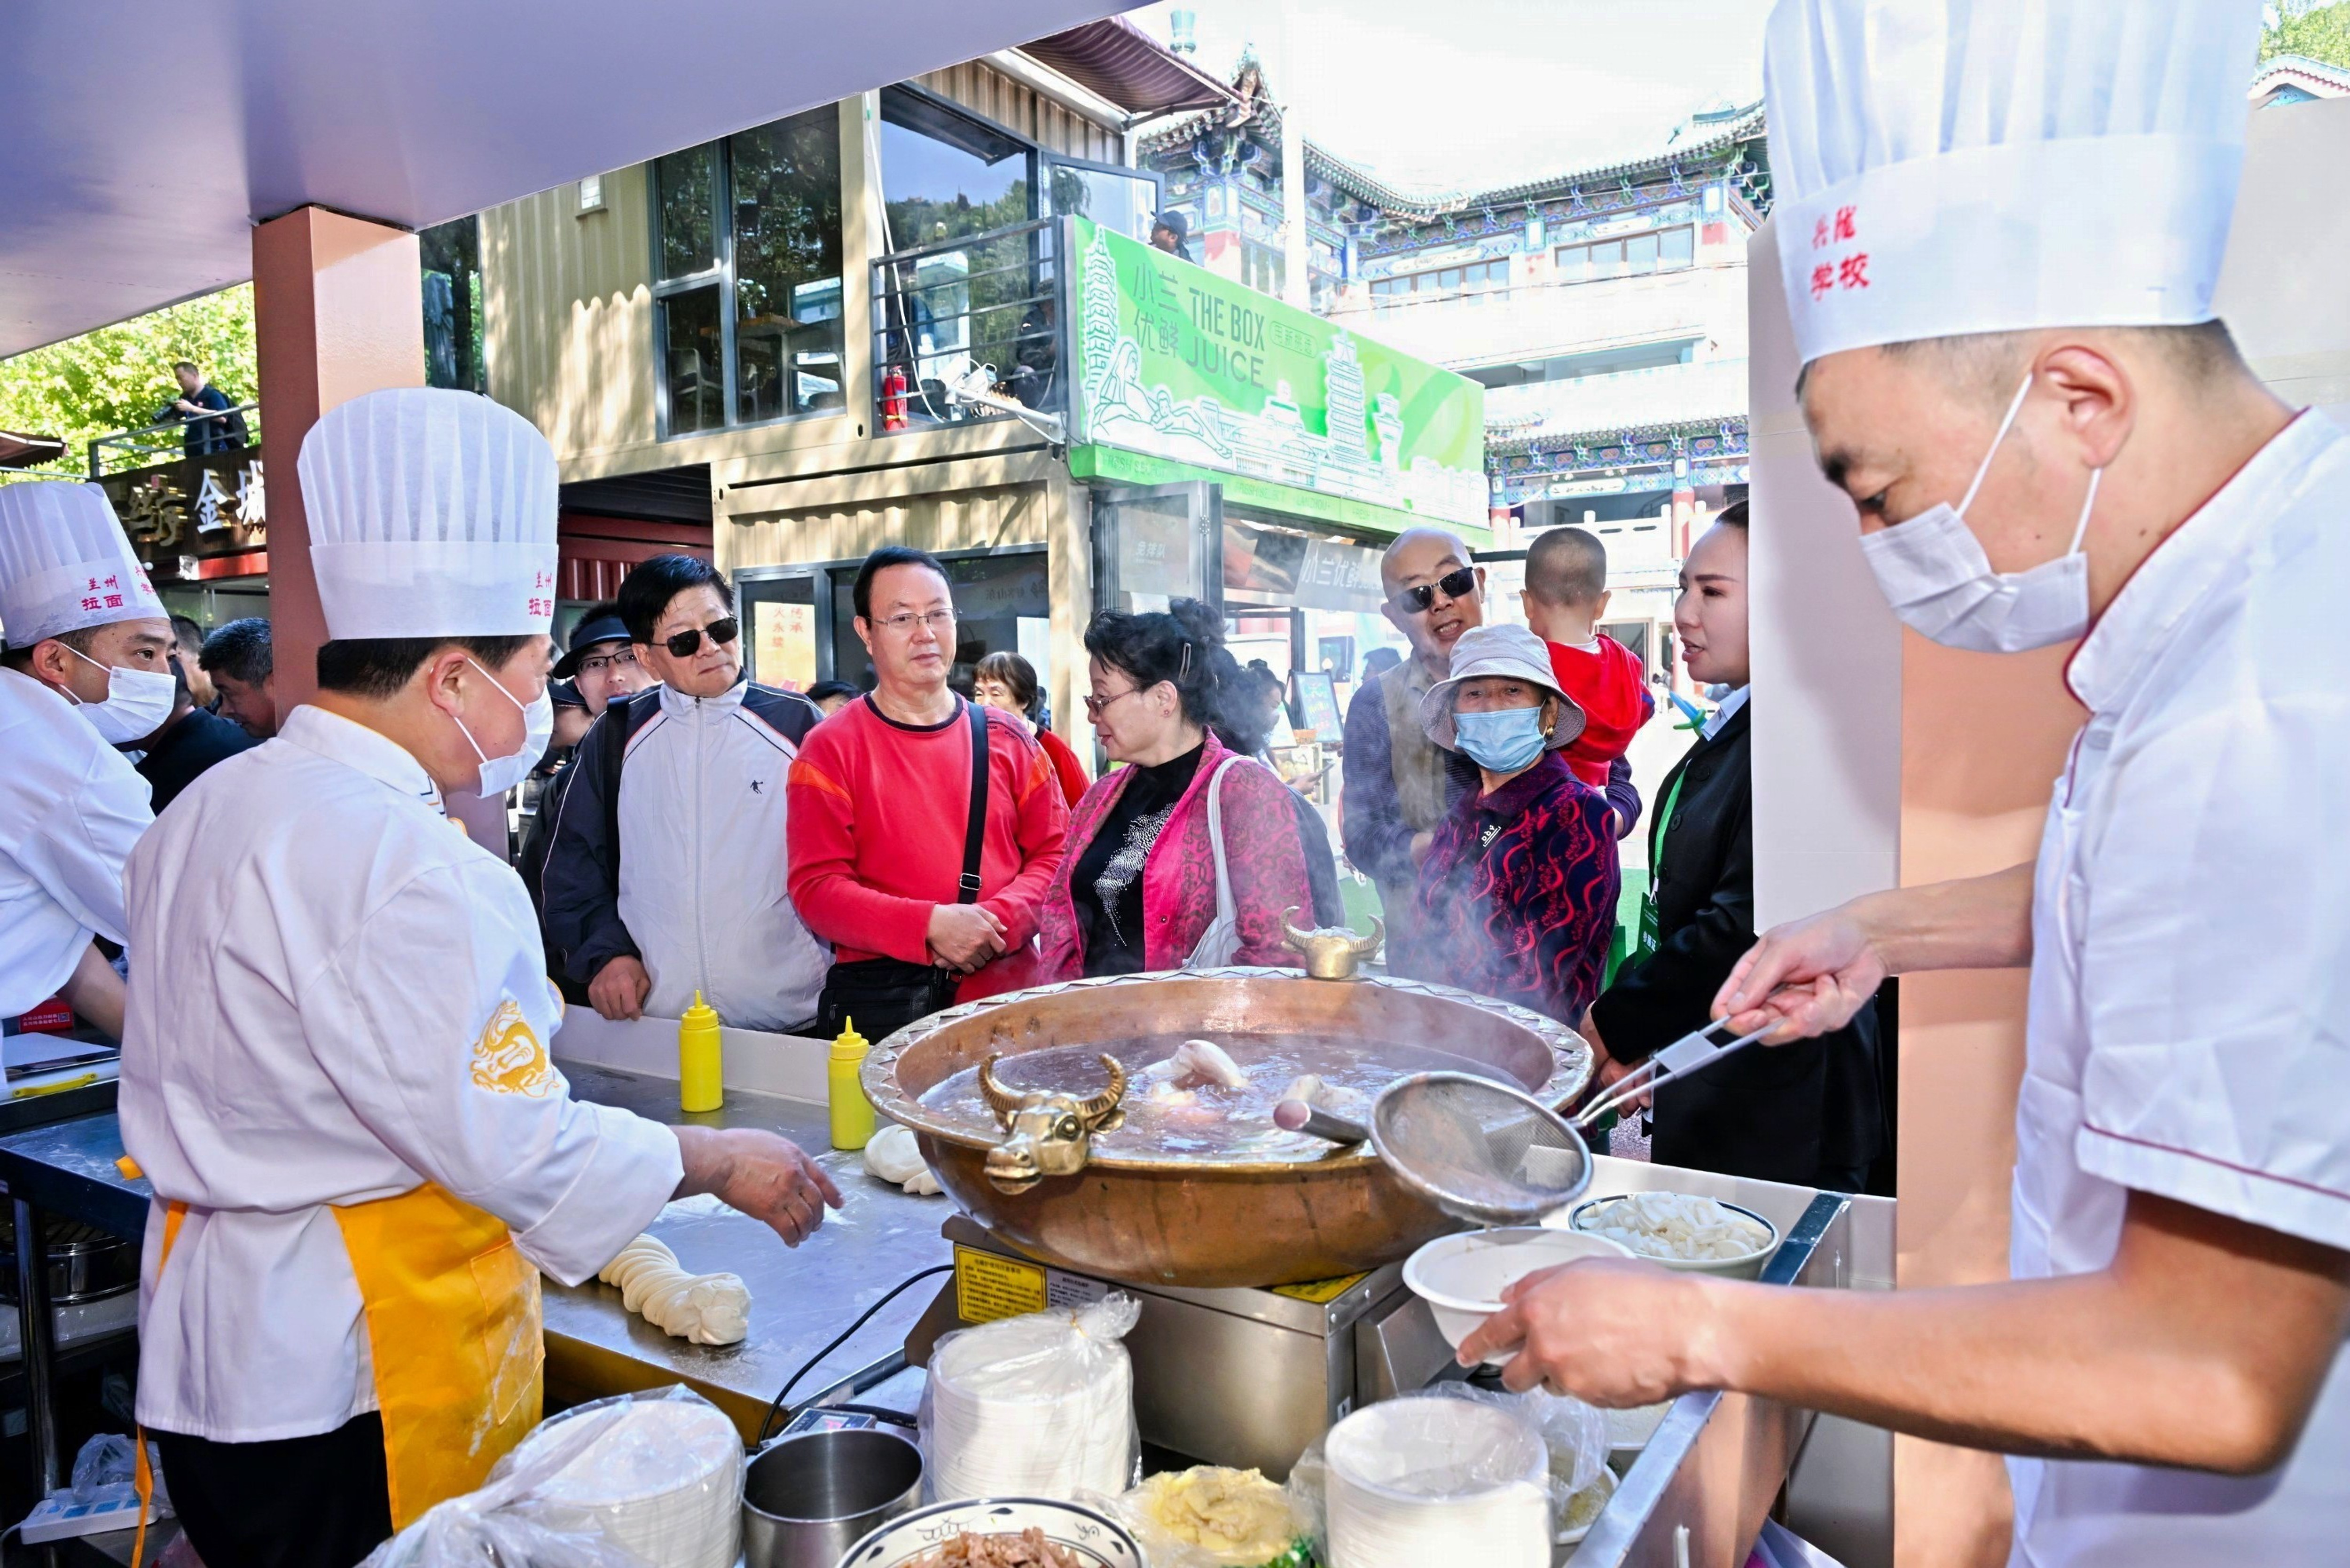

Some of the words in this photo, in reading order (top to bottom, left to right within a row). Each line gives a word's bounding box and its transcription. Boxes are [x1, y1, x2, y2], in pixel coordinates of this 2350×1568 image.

[1133, 263, 1179, 314] 小兰
[1811, 253, 1870, 302] 学校
[1134, 308, 1179, 359] 优鲜
[1189, 287, 1225, 337] THE
[1230, 304, 1265, 352] BOX
[1186, 336, 1264, 390] JUICE
[81, 594, 124, 611] 拉面
[88, 575, 118, 591] 兰州
[535, 569, 552, 593] 兰州
[529, 598, 552, 617] 拉面
